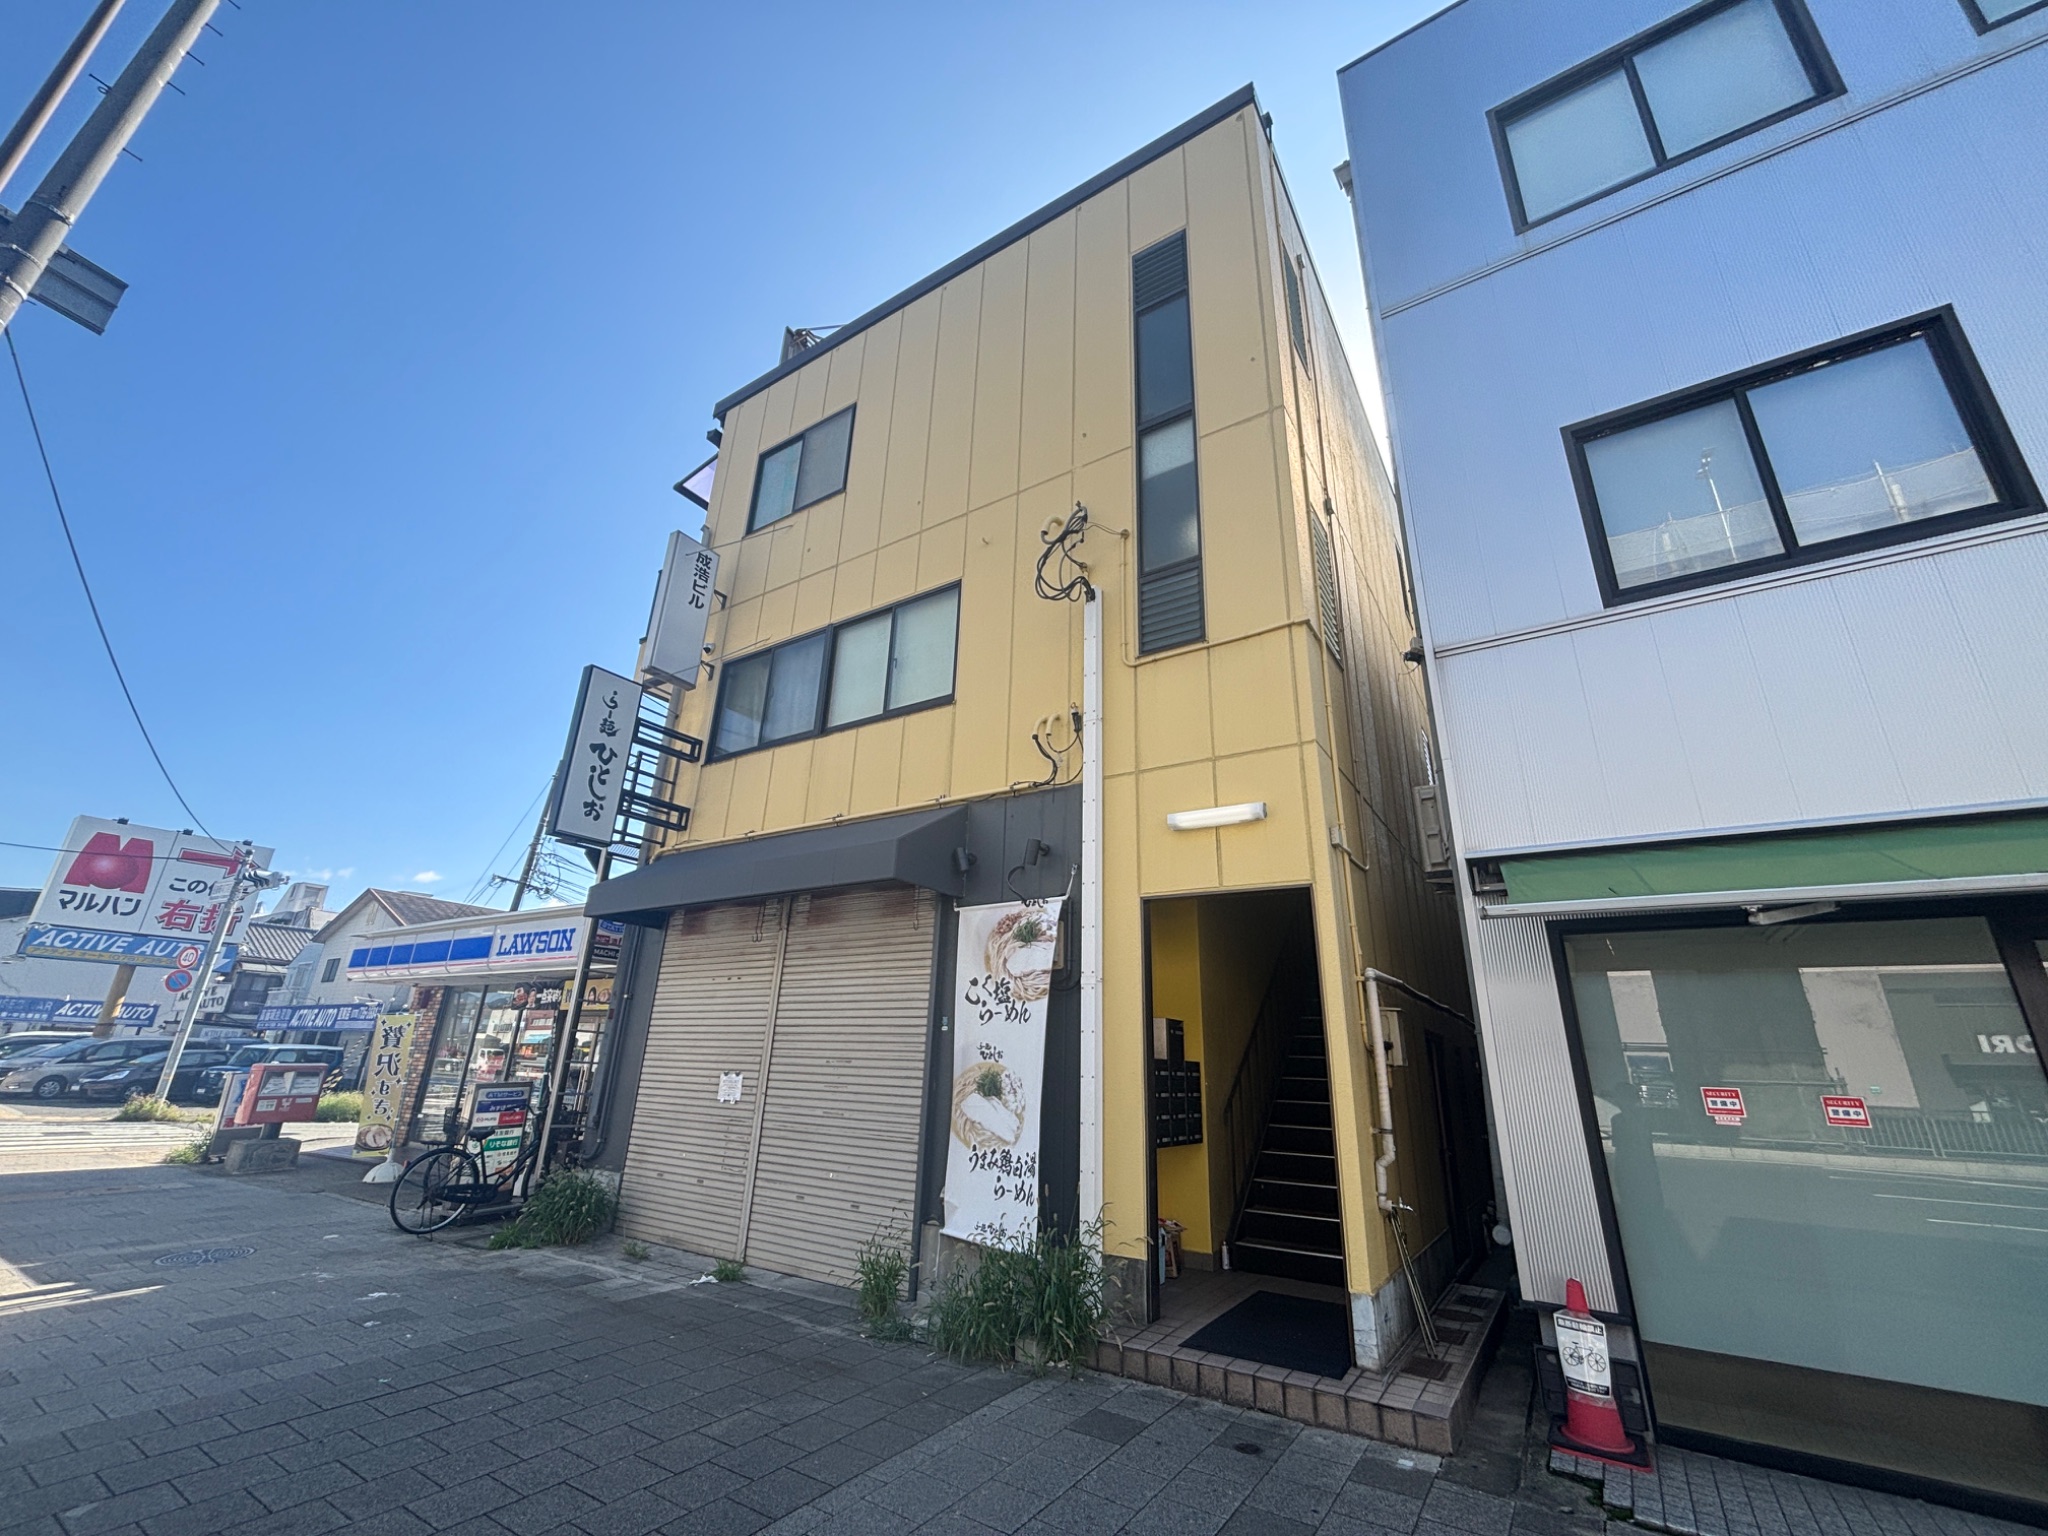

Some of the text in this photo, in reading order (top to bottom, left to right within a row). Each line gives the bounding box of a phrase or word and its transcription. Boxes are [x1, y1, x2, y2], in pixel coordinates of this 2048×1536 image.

[687, 551, 713, 610] 成浩ビル
[583, 743, 618, 821] ひとしお
[59, 889, 142, 917] マルハン
[33, 929, 134, 953] ACTIVE
[496, 927, 577, 956] LAWSON
[181, 952, 195, 963] 40
[178, 985, 218, 1001] ACVE
[965, 974, 1011, 1006] こく塩
[55, 1003, 103, 1017] ACTIV
[288, 1009, 316, 1027] ACTIVE
[313, 1008, 338, 1027] AUTO
[979, 998, 1031, 1026] らーめん
[1710, 1099, 1738, 1108] 警備中
[1826, 1099, 1860, 1107] SECURITY
[1831, 1108, 1862, 1117] 警備中
[489, 1139, 519, 1148] りそな銀行
[993, 1175, 1036, 1207] らーめん
